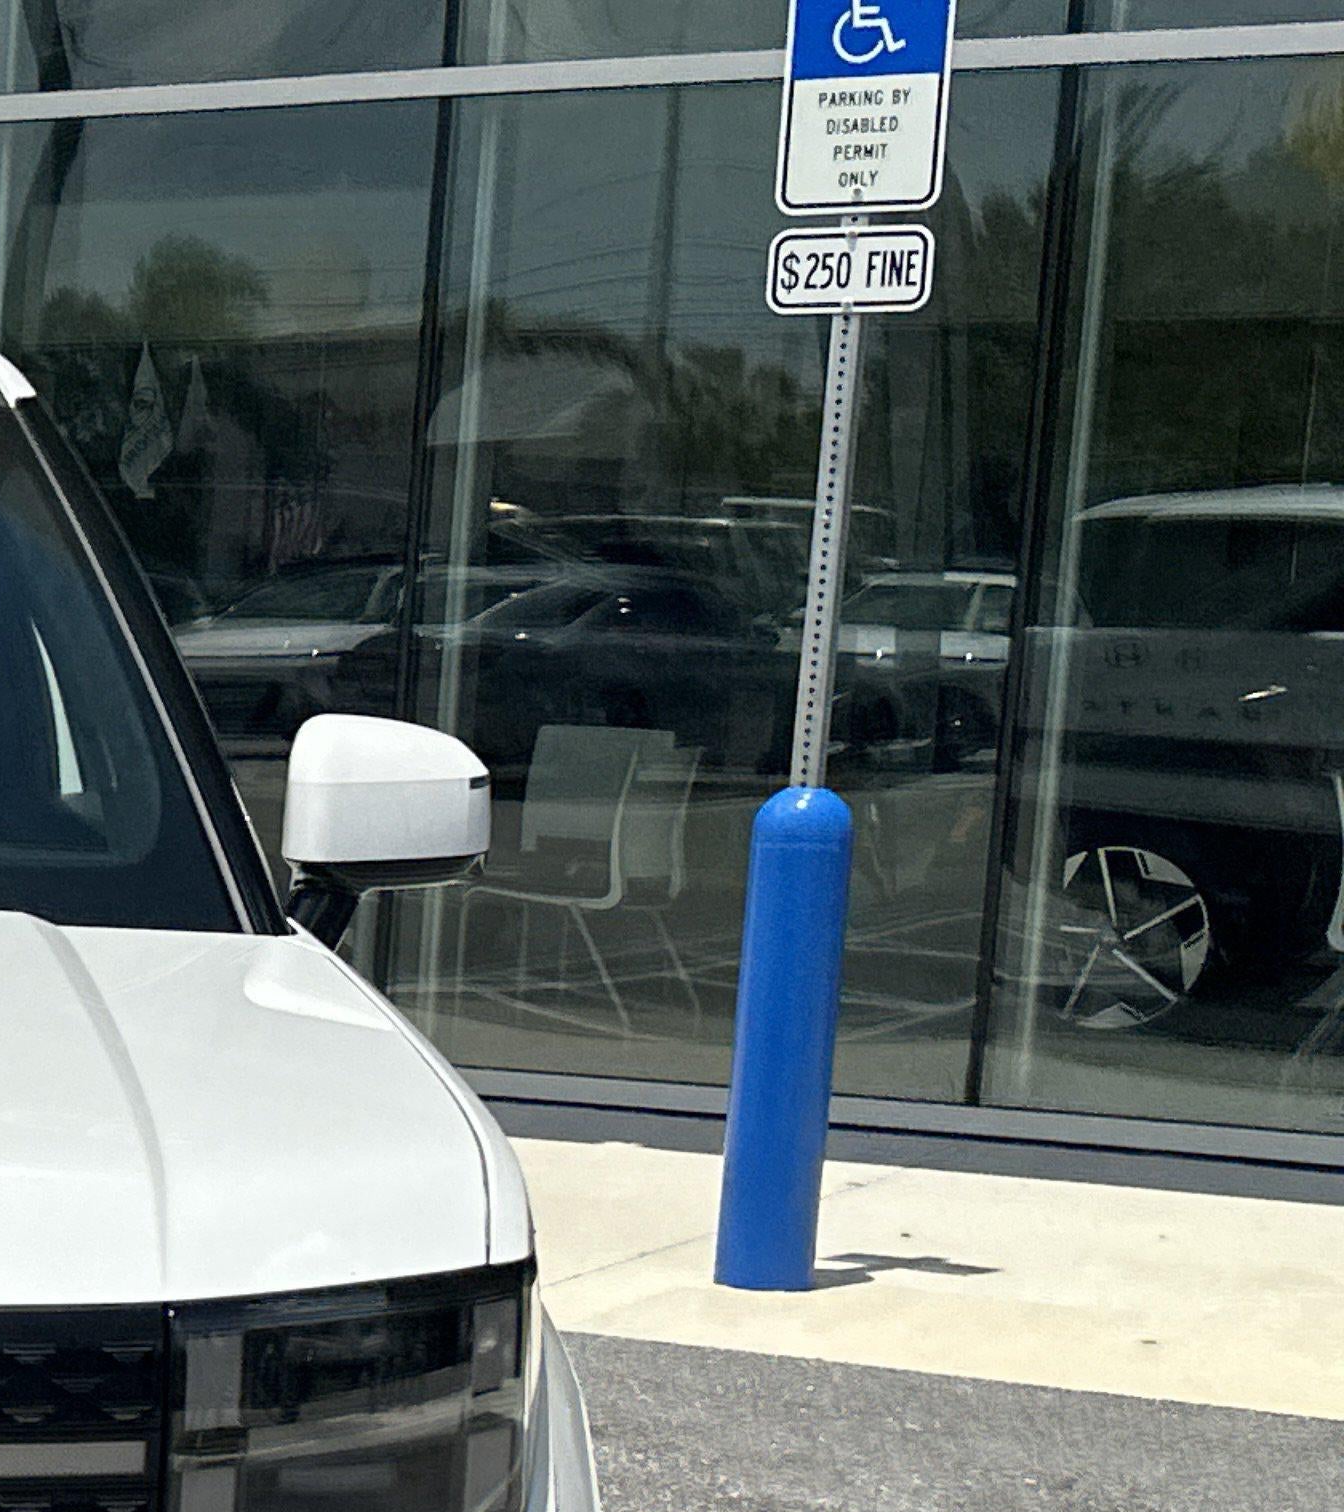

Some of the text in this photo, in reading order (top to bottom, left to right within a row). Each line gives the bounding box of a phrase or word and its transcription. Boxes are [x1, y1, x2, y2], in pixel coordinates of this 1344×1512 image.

[818, 88, 912, 108] PARKING BY
[826, 116, 899, 135] DISABLED
[833, 144, 889, 161] PERMIT
[838, 171, 879, 188] ONLY
[780, 250, 920, 294] $250 FINE
